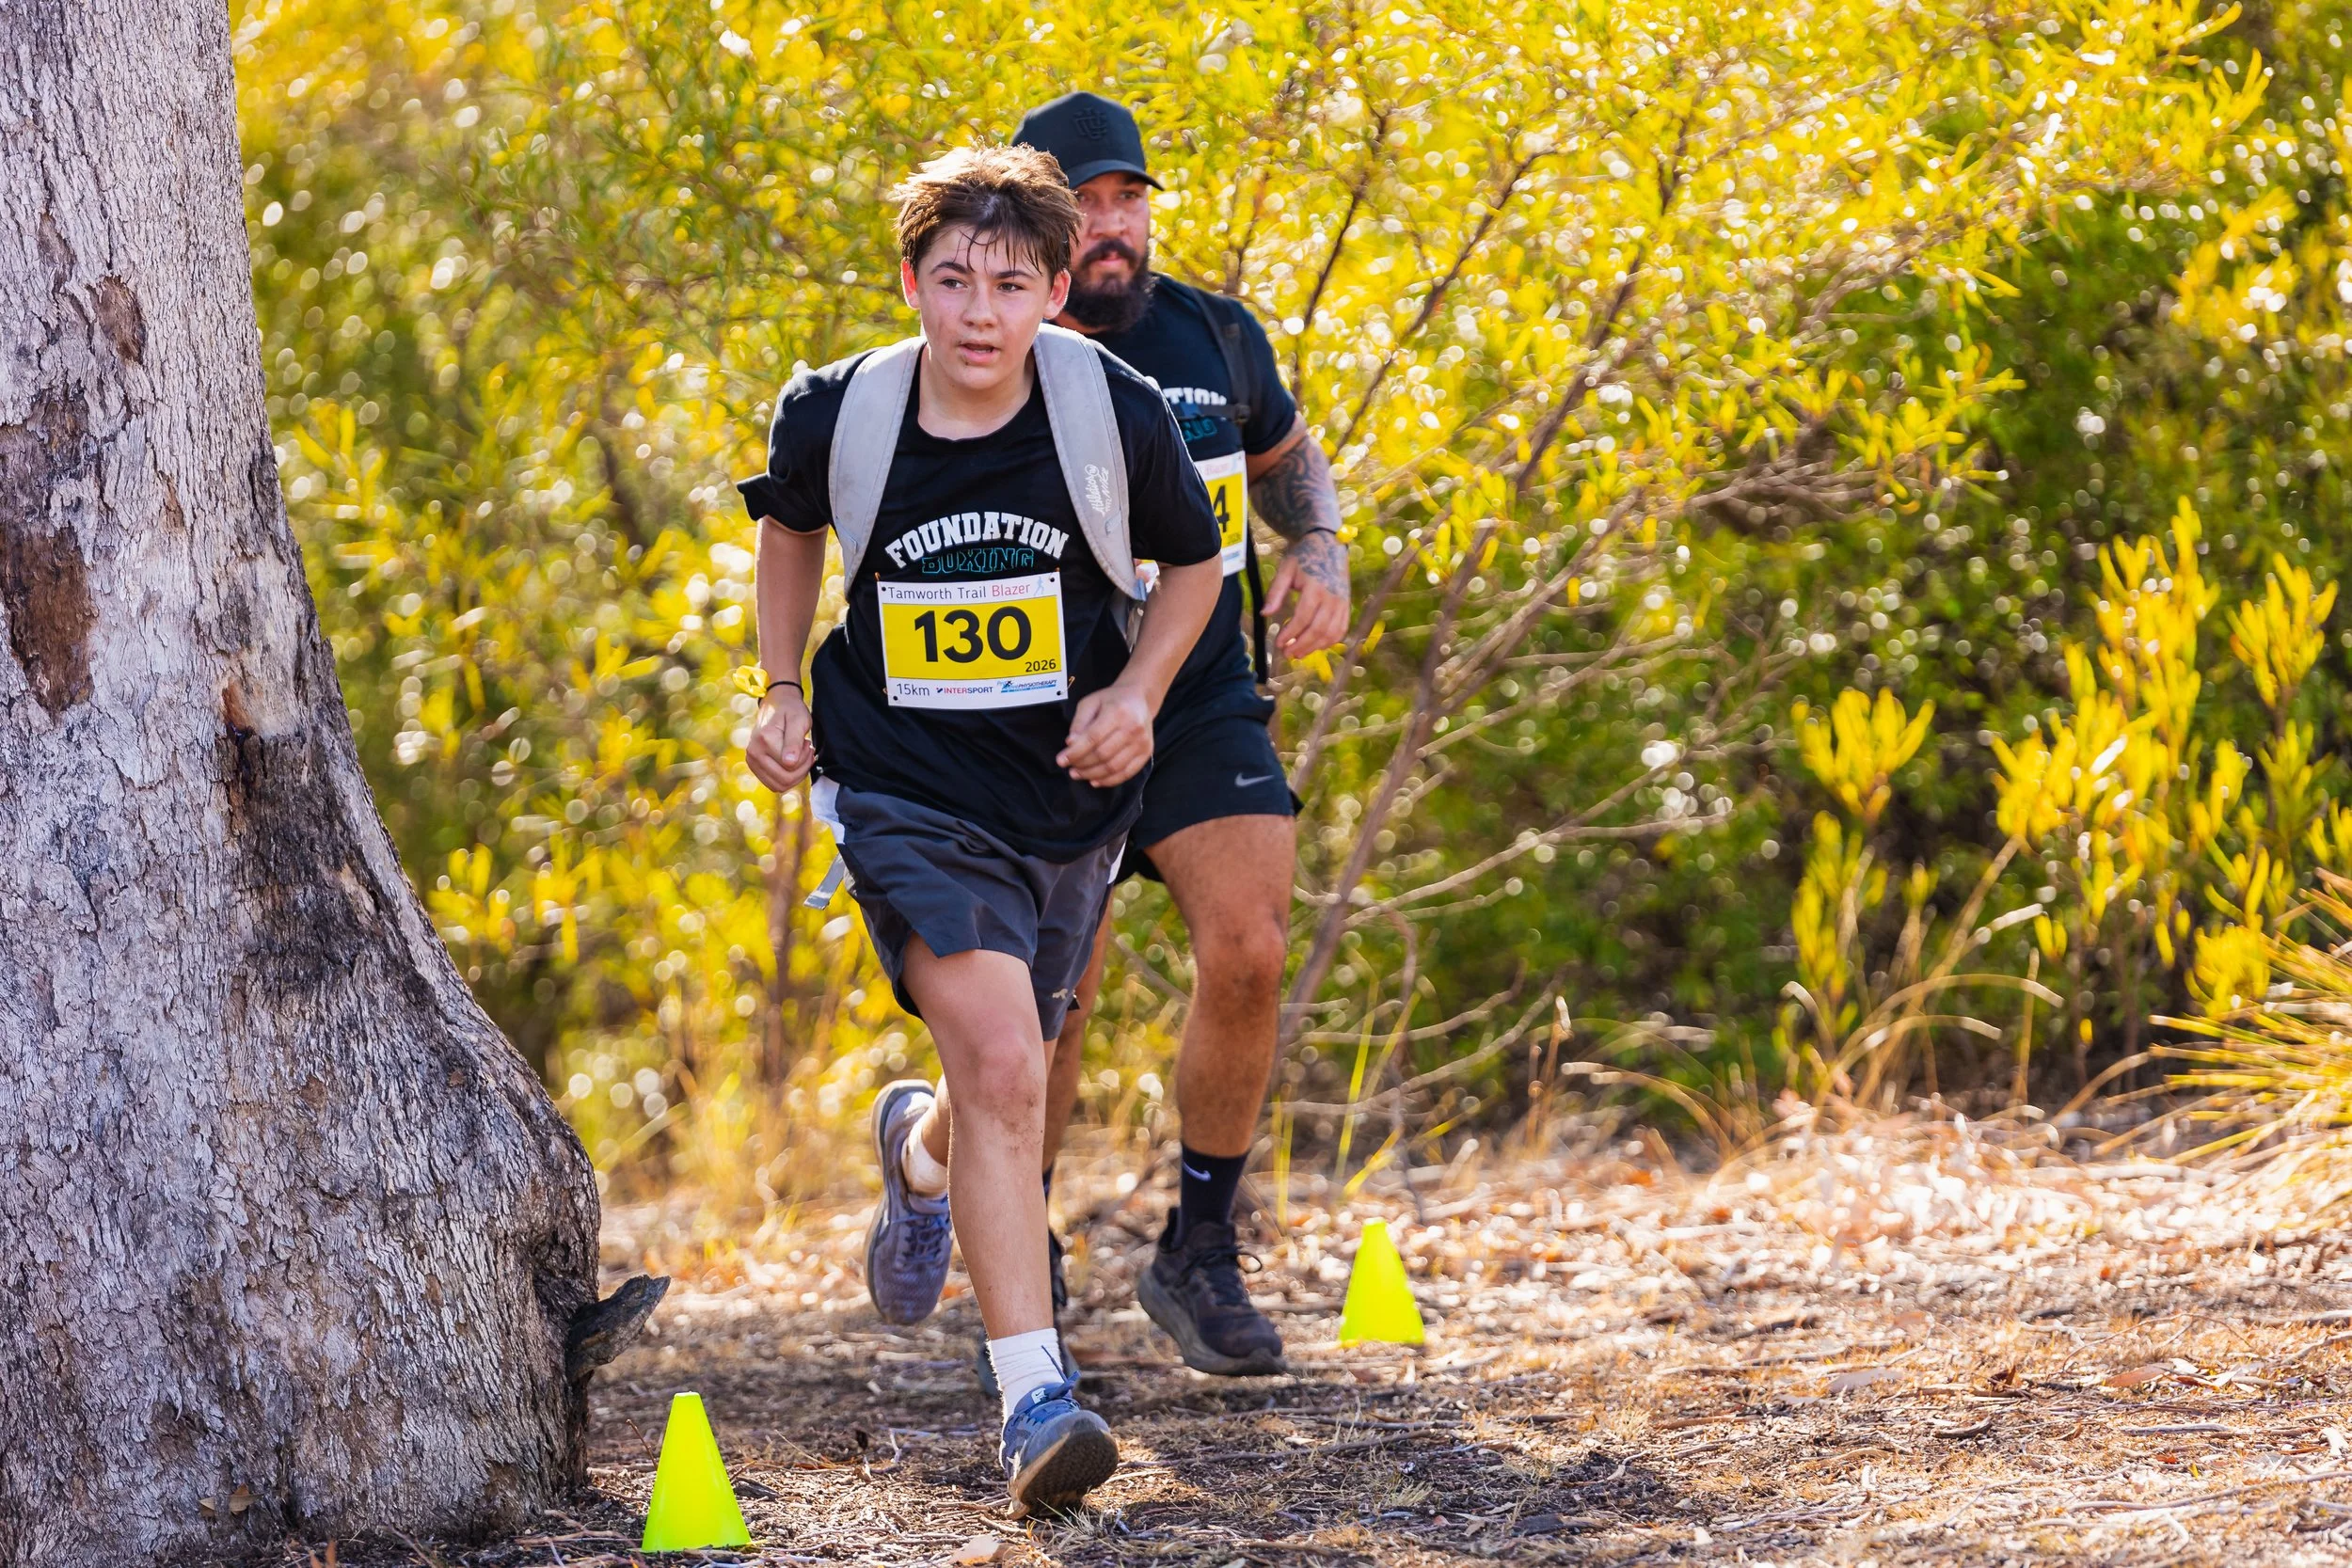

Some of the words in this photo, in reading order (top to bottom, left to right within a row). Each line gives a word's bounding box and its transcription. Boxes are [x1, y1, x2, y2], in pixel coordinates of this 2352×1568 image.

[884, 511, 1070, 569] FOUNDATION
[922, 547, 1034, 575] BOXING
[888, 586, 952, 600] Tamworth
[958, 585, 987, 599] Trail
[992, 583, 1030, 597] Blazer
[914, 606, 1032, 663] 130
[1025, 658, 1057, 673] 2026
[897, 683, 930, 696] 15km
[944, 686, 993, 694] INTERSPORT
